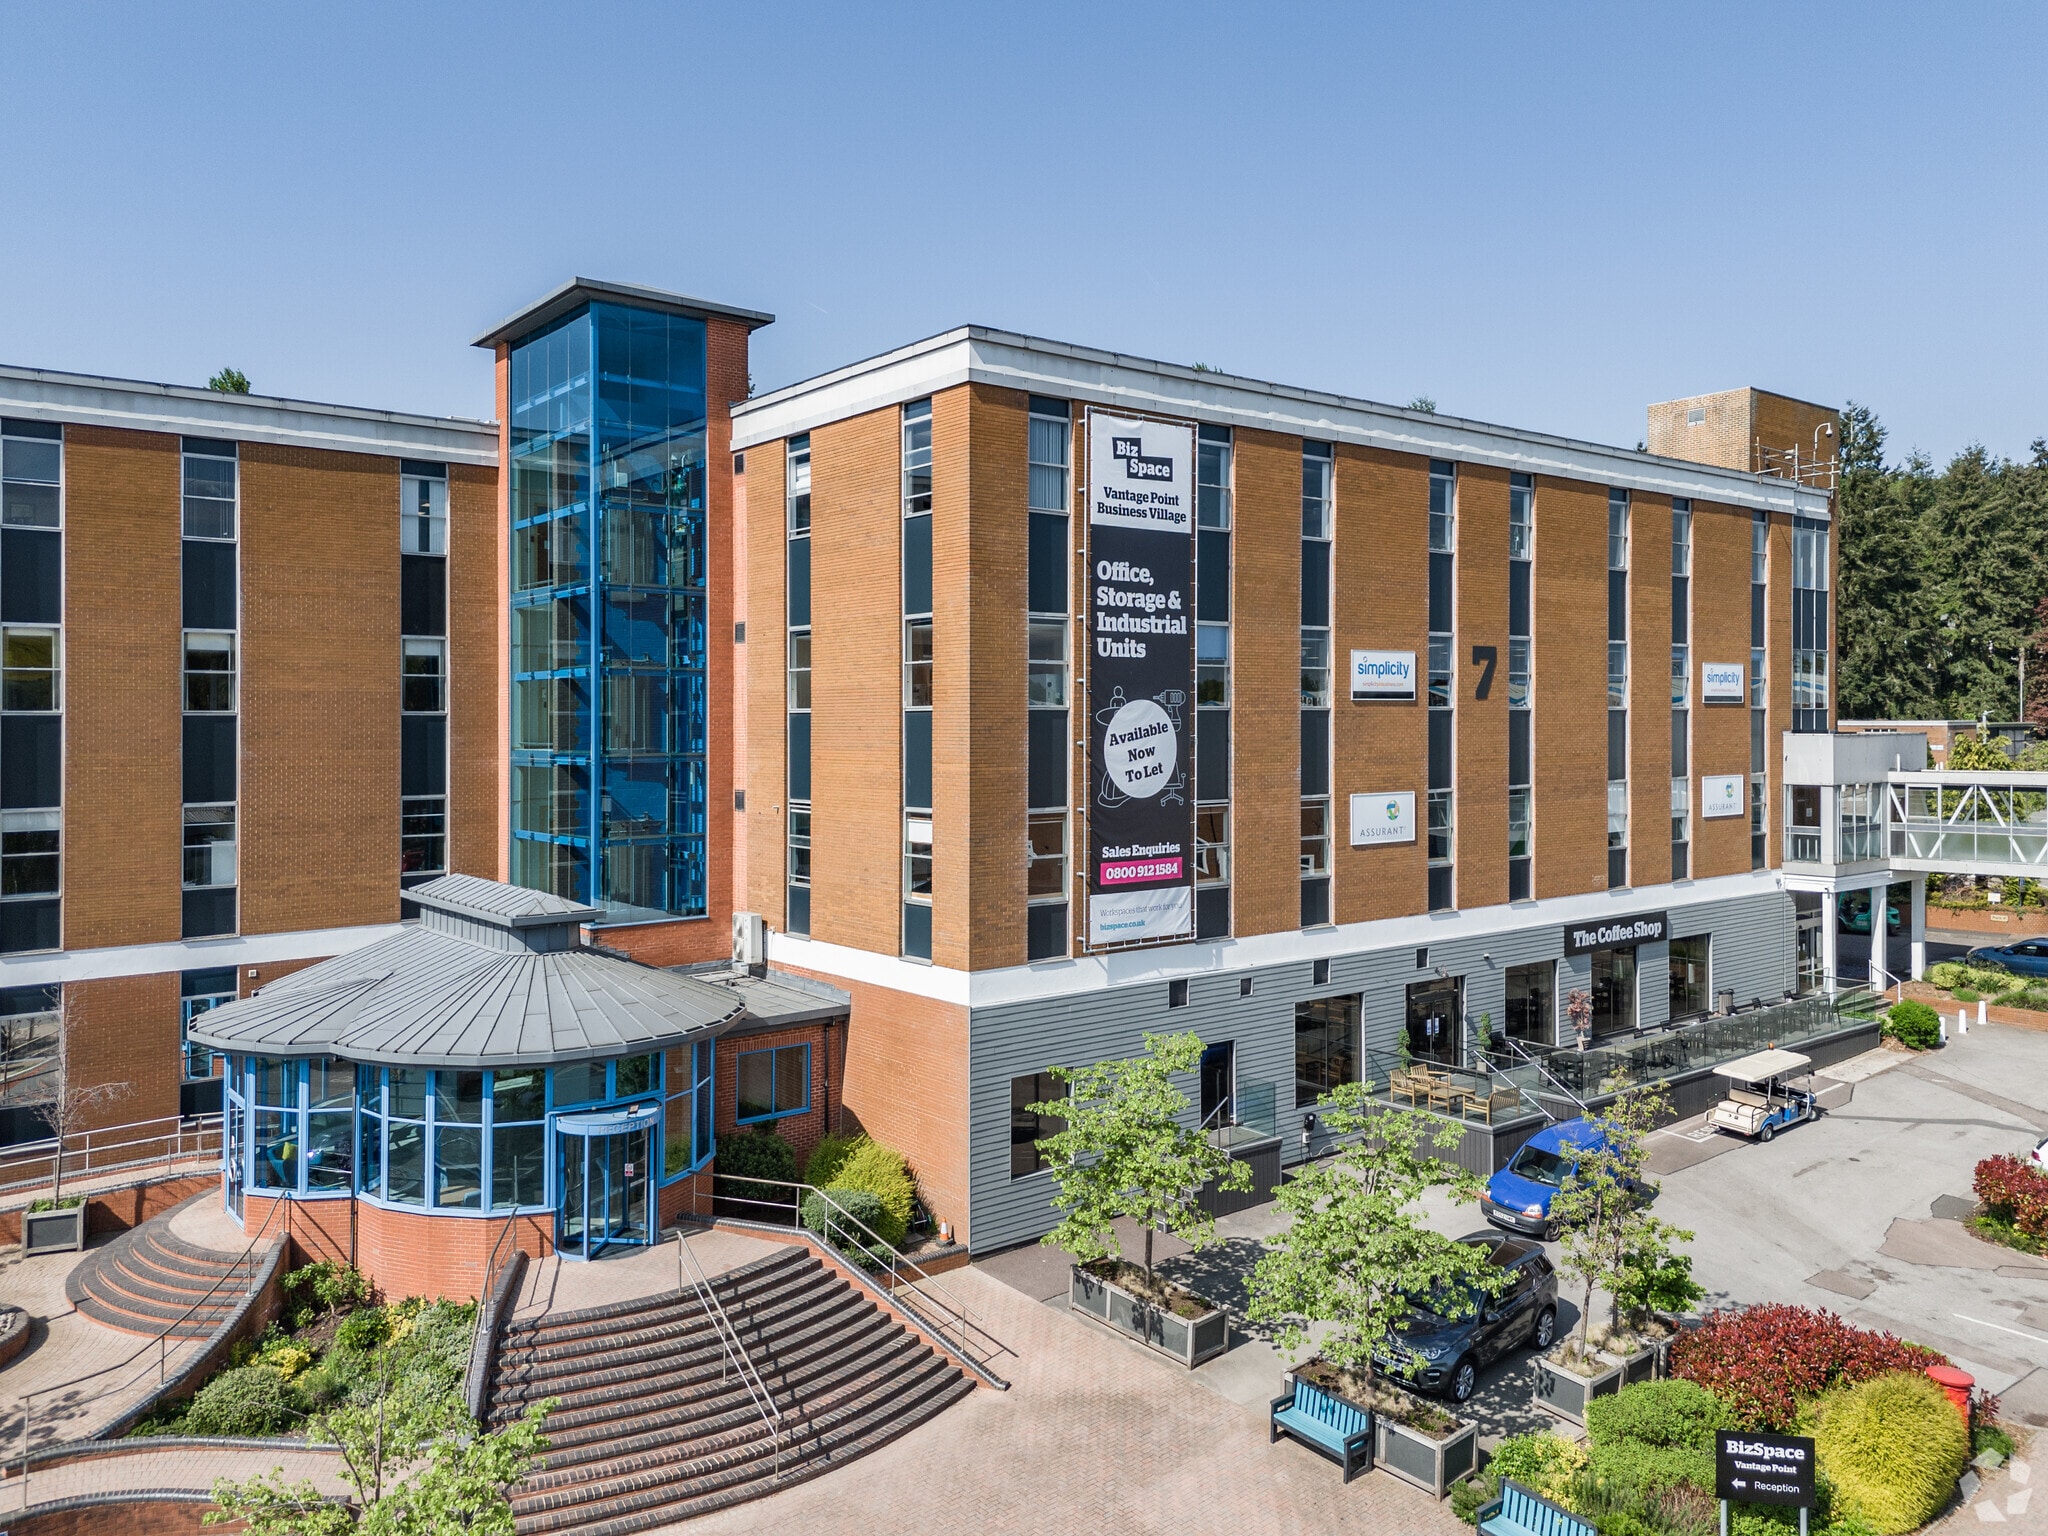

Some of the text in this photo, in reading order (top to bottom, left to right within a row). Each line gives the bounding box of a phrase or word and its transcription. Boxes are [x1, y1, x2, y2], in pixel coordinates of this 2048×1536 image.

[1116, 440, 1138, 457] Biz
[1129, 459, 1170, 478] Space
[1104, 486, 1179, 506] Vantage Point
[1097, 502, 1187, 523] Business Village
[1097, 561, 1154, 586] Office,
[1096, 586, 1182, 612] Storage &
[1096, 612, 1187, 635] Industrial
[1096, 637, 1147, 658] Units
[1357, 657, 1409, 679] simplicity
[1472, 645, 1497, 700] 7
[1707, 670, 1740, 686] simplicity
[1109, 722, 1169, 746] Available
[1128, 745, 1156, 762] Now
[1125, 762, 1164, 783] To Let
[1709, 803, 1736, 811] ASSURANT
[1360, 826, 1404, 837] ASSURANT
[1102, 842, 1181, 859] Sales Enquiries
[1106, 862, 1179, 880] 0800 912 1584
[1100, 907, 1136, 917] Workspaces
[1136, 905, 1147, 913] that
[1148, 904, 1162, 912] work
[1100, 920, 1145, 930] bizspace.co.uk
[1573, 921, 1662, 948] The Coffee Shop
[599, 1117, 655, 1134] RECEPTION
[1726, 1440, 1805, 1460] BizSpace
[1734, 1460, 1797, 1474] Vantage Point
[1754, 1481, 1800, 1494] Reception
